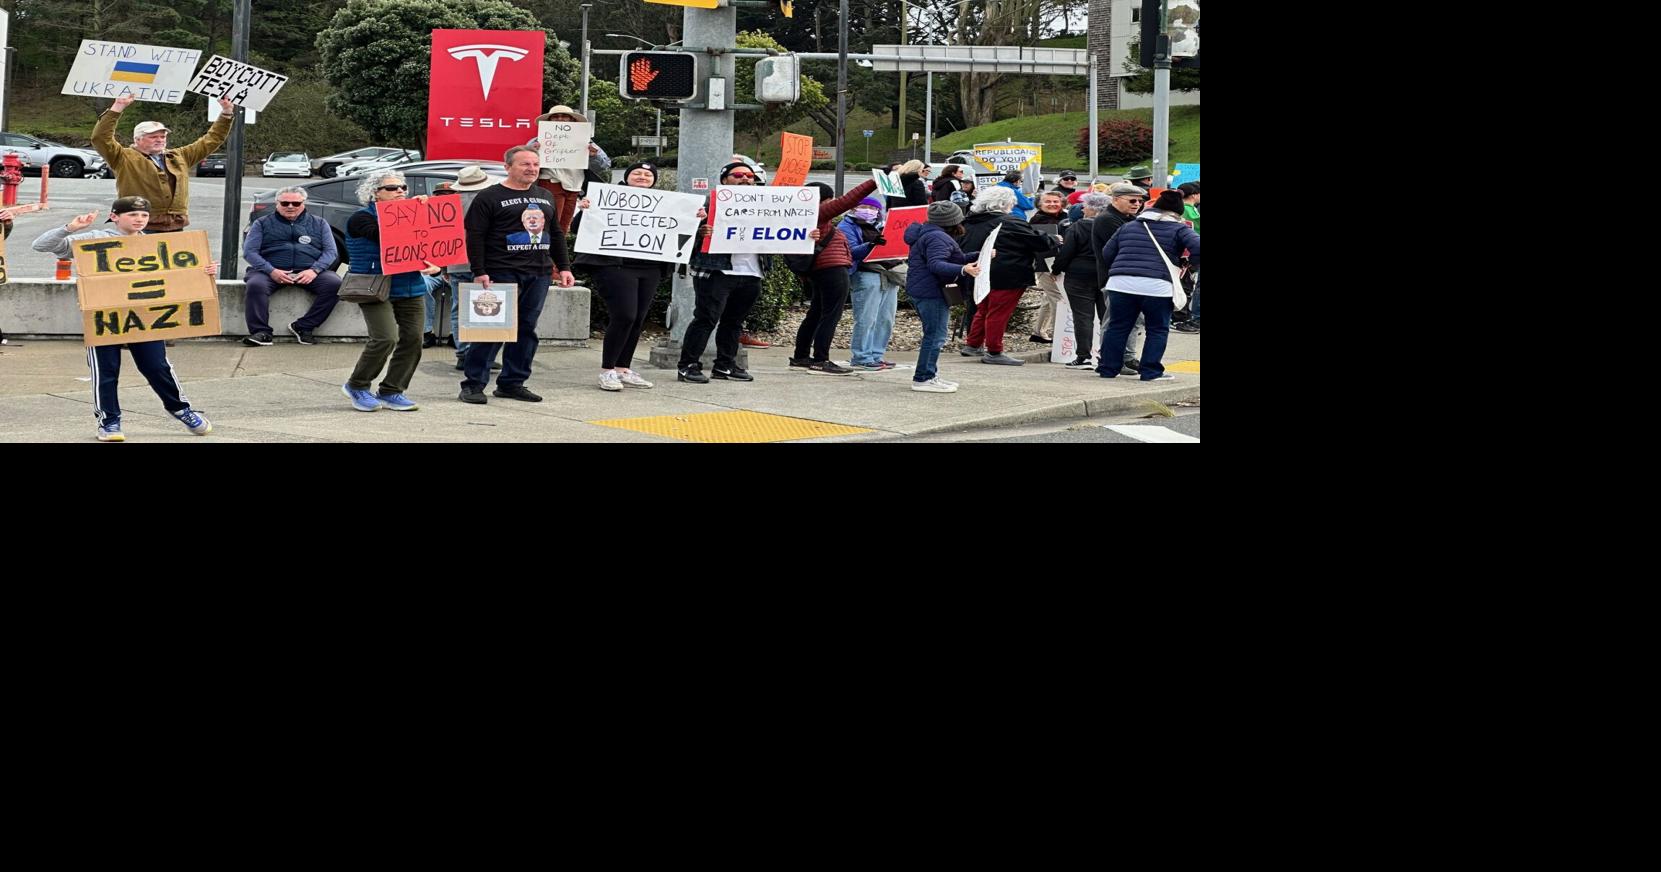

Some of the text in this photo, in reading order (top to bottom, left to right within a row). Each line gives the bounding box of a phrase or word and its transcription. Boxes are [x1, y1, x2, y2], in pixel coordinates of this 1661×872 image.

[84, 44, 198, 64] STAND WITH
[203, 57, 285, 93] BOYCOTT
[73, 81, 180, 102] UKRAINE
[191, 75, 248, 105] TESLA
[440, 117, 530, 128] TESLA
[785, 135, 810, 156] STOP
[782, 158, 809, 176] DOGE
[501, 197, 522, 208] ELECT
[598, 189, 663, 212] NOBODY
[734, 192, 793, 204] DON'T BUY
[384, 202, 456, 227] SAY NO
[607, 213, 678, 230] ELECTED
[725, 207, 814, 218] CARS FROM NAZIS
[413, 230, 428, 240] TO
[752, 227, 806, 241] ELON
[80, 241, 199, 273] Tesla
[384, 238, 464, 263] ELON'S COUP
[94, 301, 204, 337] NAZI
[1061, 336, 1073, 356] STOP
